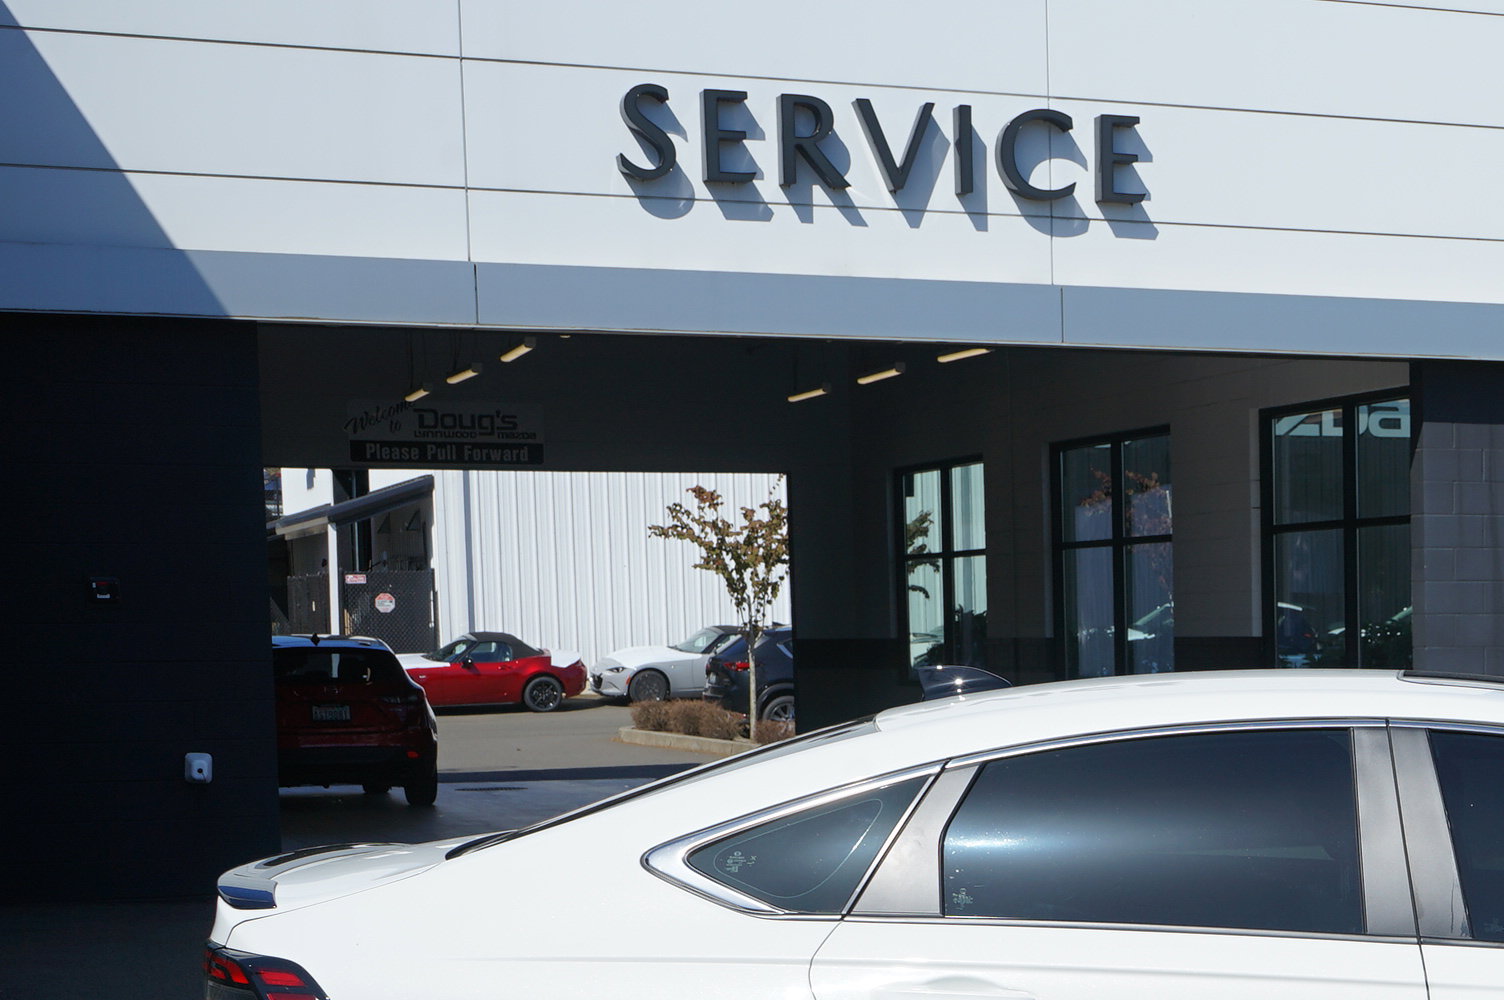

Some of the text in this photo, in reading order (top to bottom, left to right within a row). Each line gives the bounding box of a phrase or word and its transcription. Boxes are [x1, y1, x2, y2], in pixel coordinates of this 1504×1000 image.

[616, 83, 1147, 206] SERVICE
[344, 401, 416, 434] Welcome
[390, 419, 402, 433] to
[413, 408, 518, 436] Doug's
[366, 443, 529, 461] Please Pull Forward
